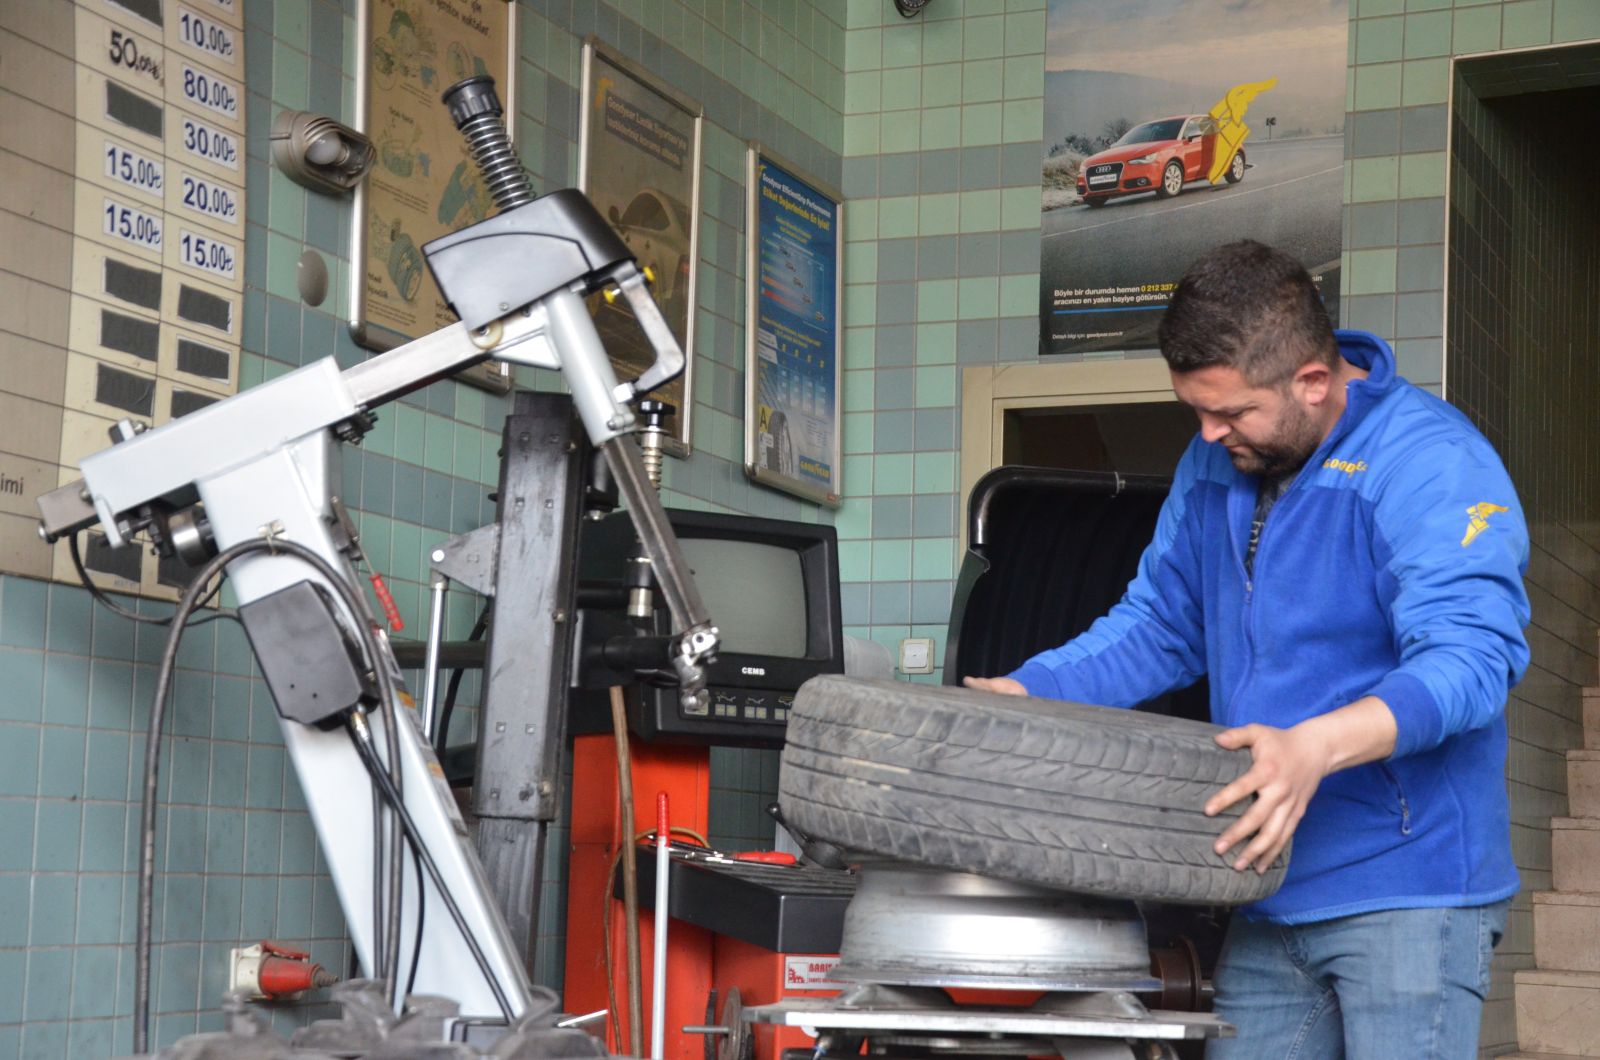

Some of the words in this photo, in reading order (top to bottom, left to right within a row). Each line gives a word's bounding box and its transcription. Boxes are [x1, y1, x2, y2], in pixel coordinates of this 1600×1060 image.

[1054, 289, 1073, 298] Böyle
[1085, 287, 1116, 295] durumda
[1116, 286, 1140, 294] hemen
[1147, 284, 1160, 292] 212
[1113, 295, 1135, 303] bayiye
[741, 667, 766, 676] CEMB
